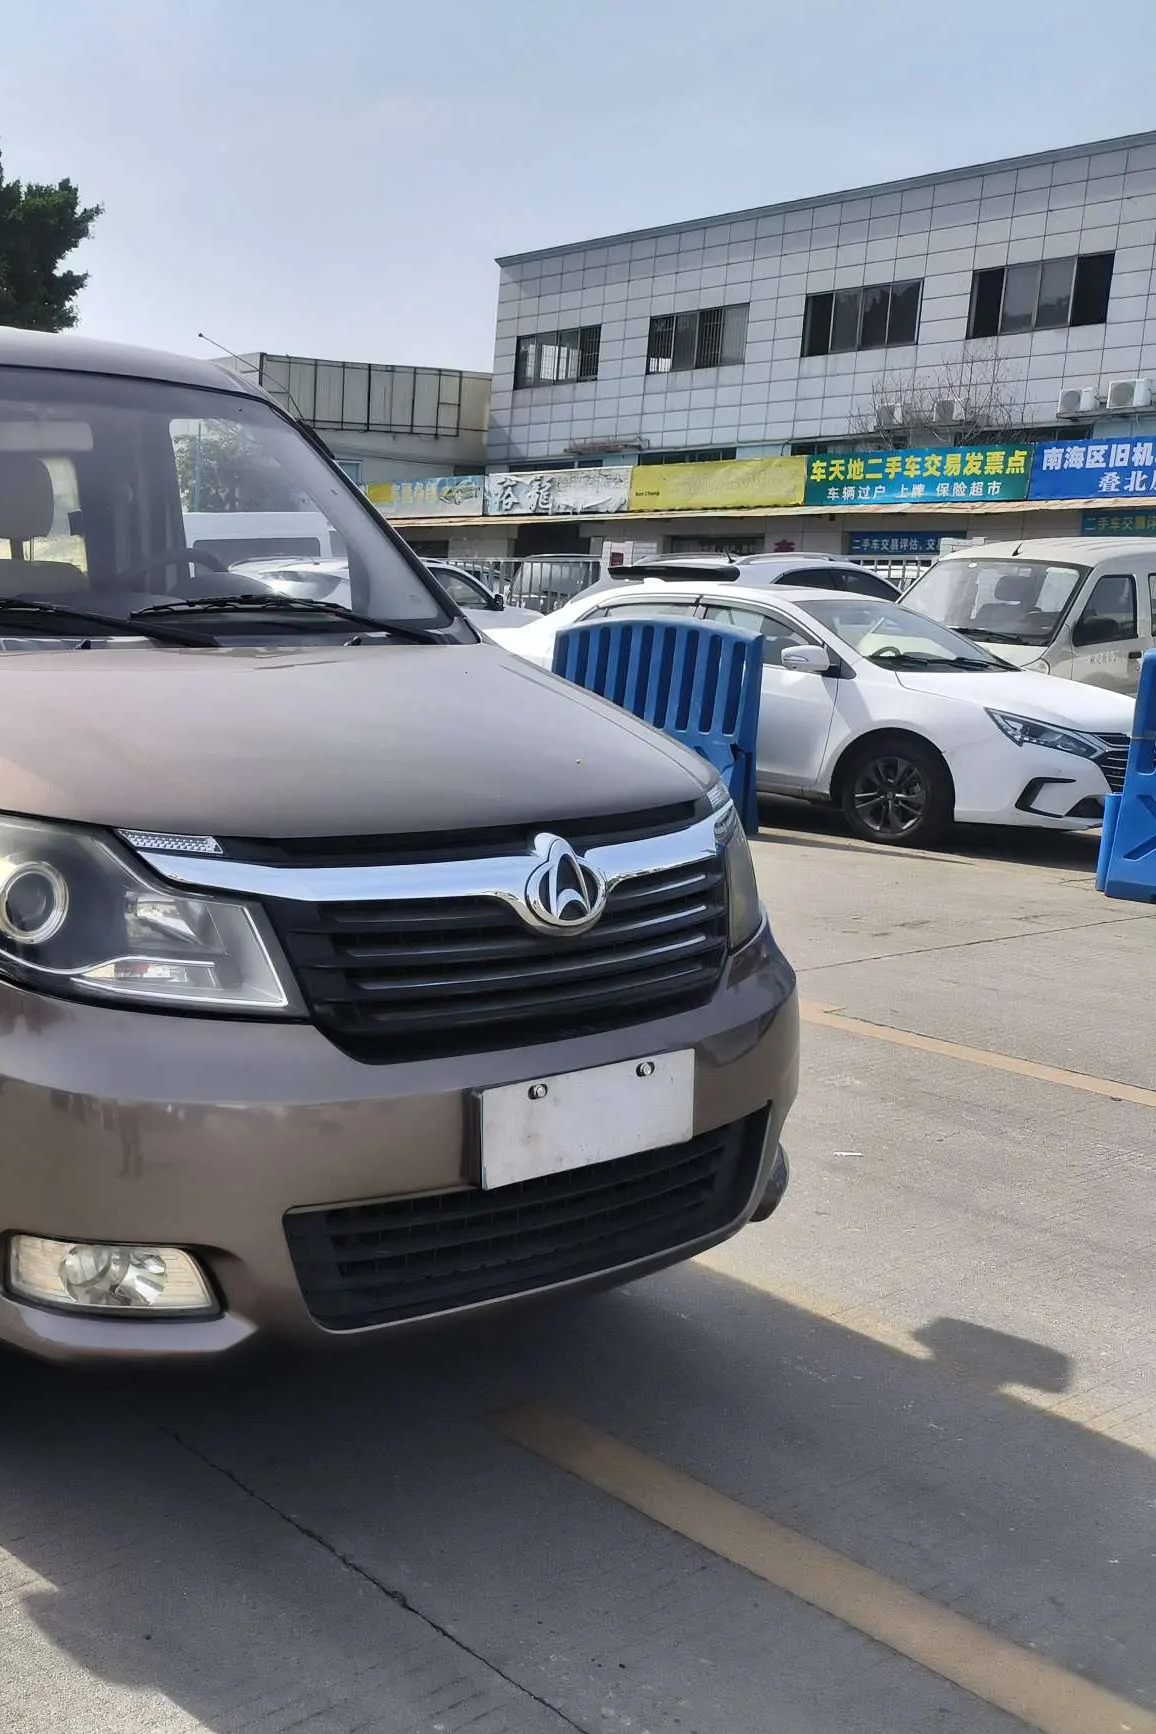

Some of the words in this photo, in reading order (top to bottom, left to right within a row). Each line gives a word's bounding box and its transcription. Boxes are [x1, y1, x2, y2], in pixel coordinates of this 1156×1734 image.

[810, 449, 1028, 482] 车天地二手车交易发票点
[1042, 442, 1156, 470] 南海区旧机
[827, 484, 886, 501] 车辆过户
[895, 484, 925, 499] 上牌
[935, 481, 1002, 498] 保险超市
[852, 538, 940, 551] 二手车交易评估、交
